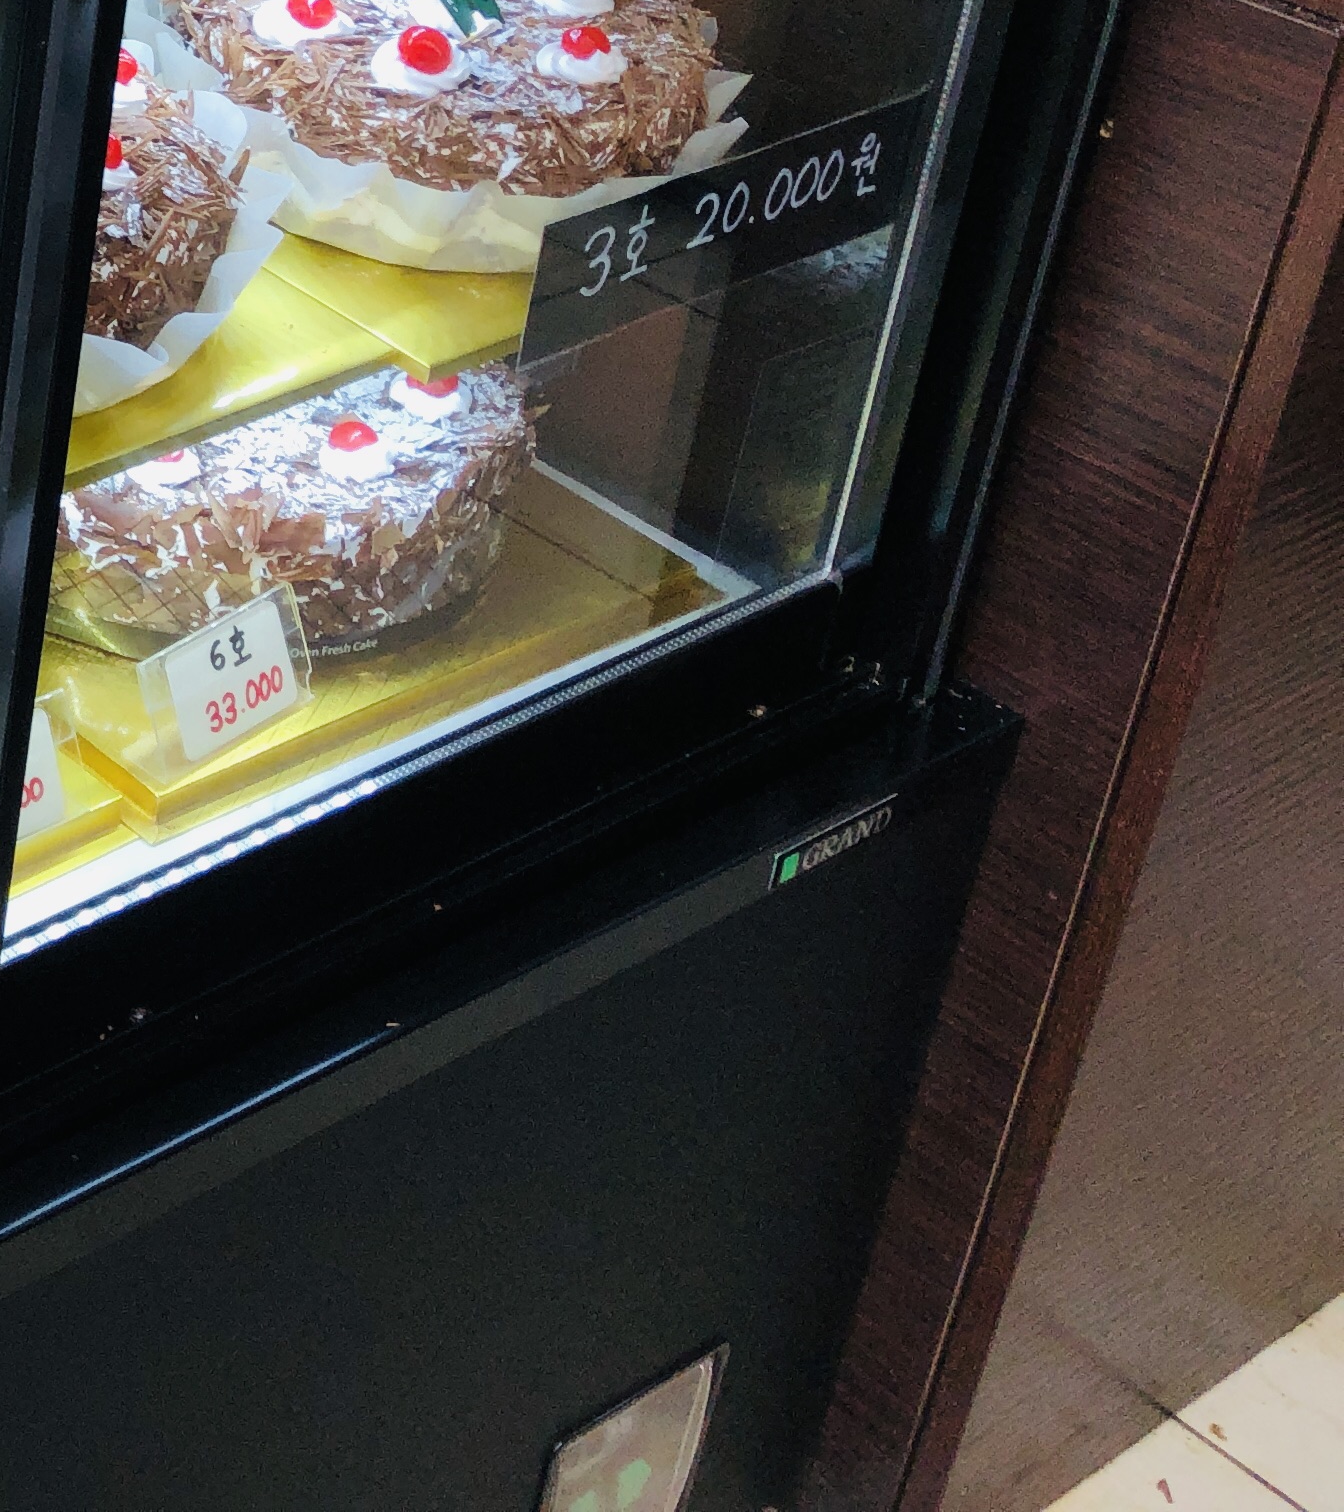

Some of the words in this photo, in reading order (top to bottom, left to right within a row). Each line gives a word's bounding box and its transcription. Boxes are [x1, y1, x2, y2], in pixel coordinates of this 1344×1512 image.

[580, 204, 655, 297] 3호
[210, 625, 252, 672] 6호
[204, 664, 284, 734] 33.000
